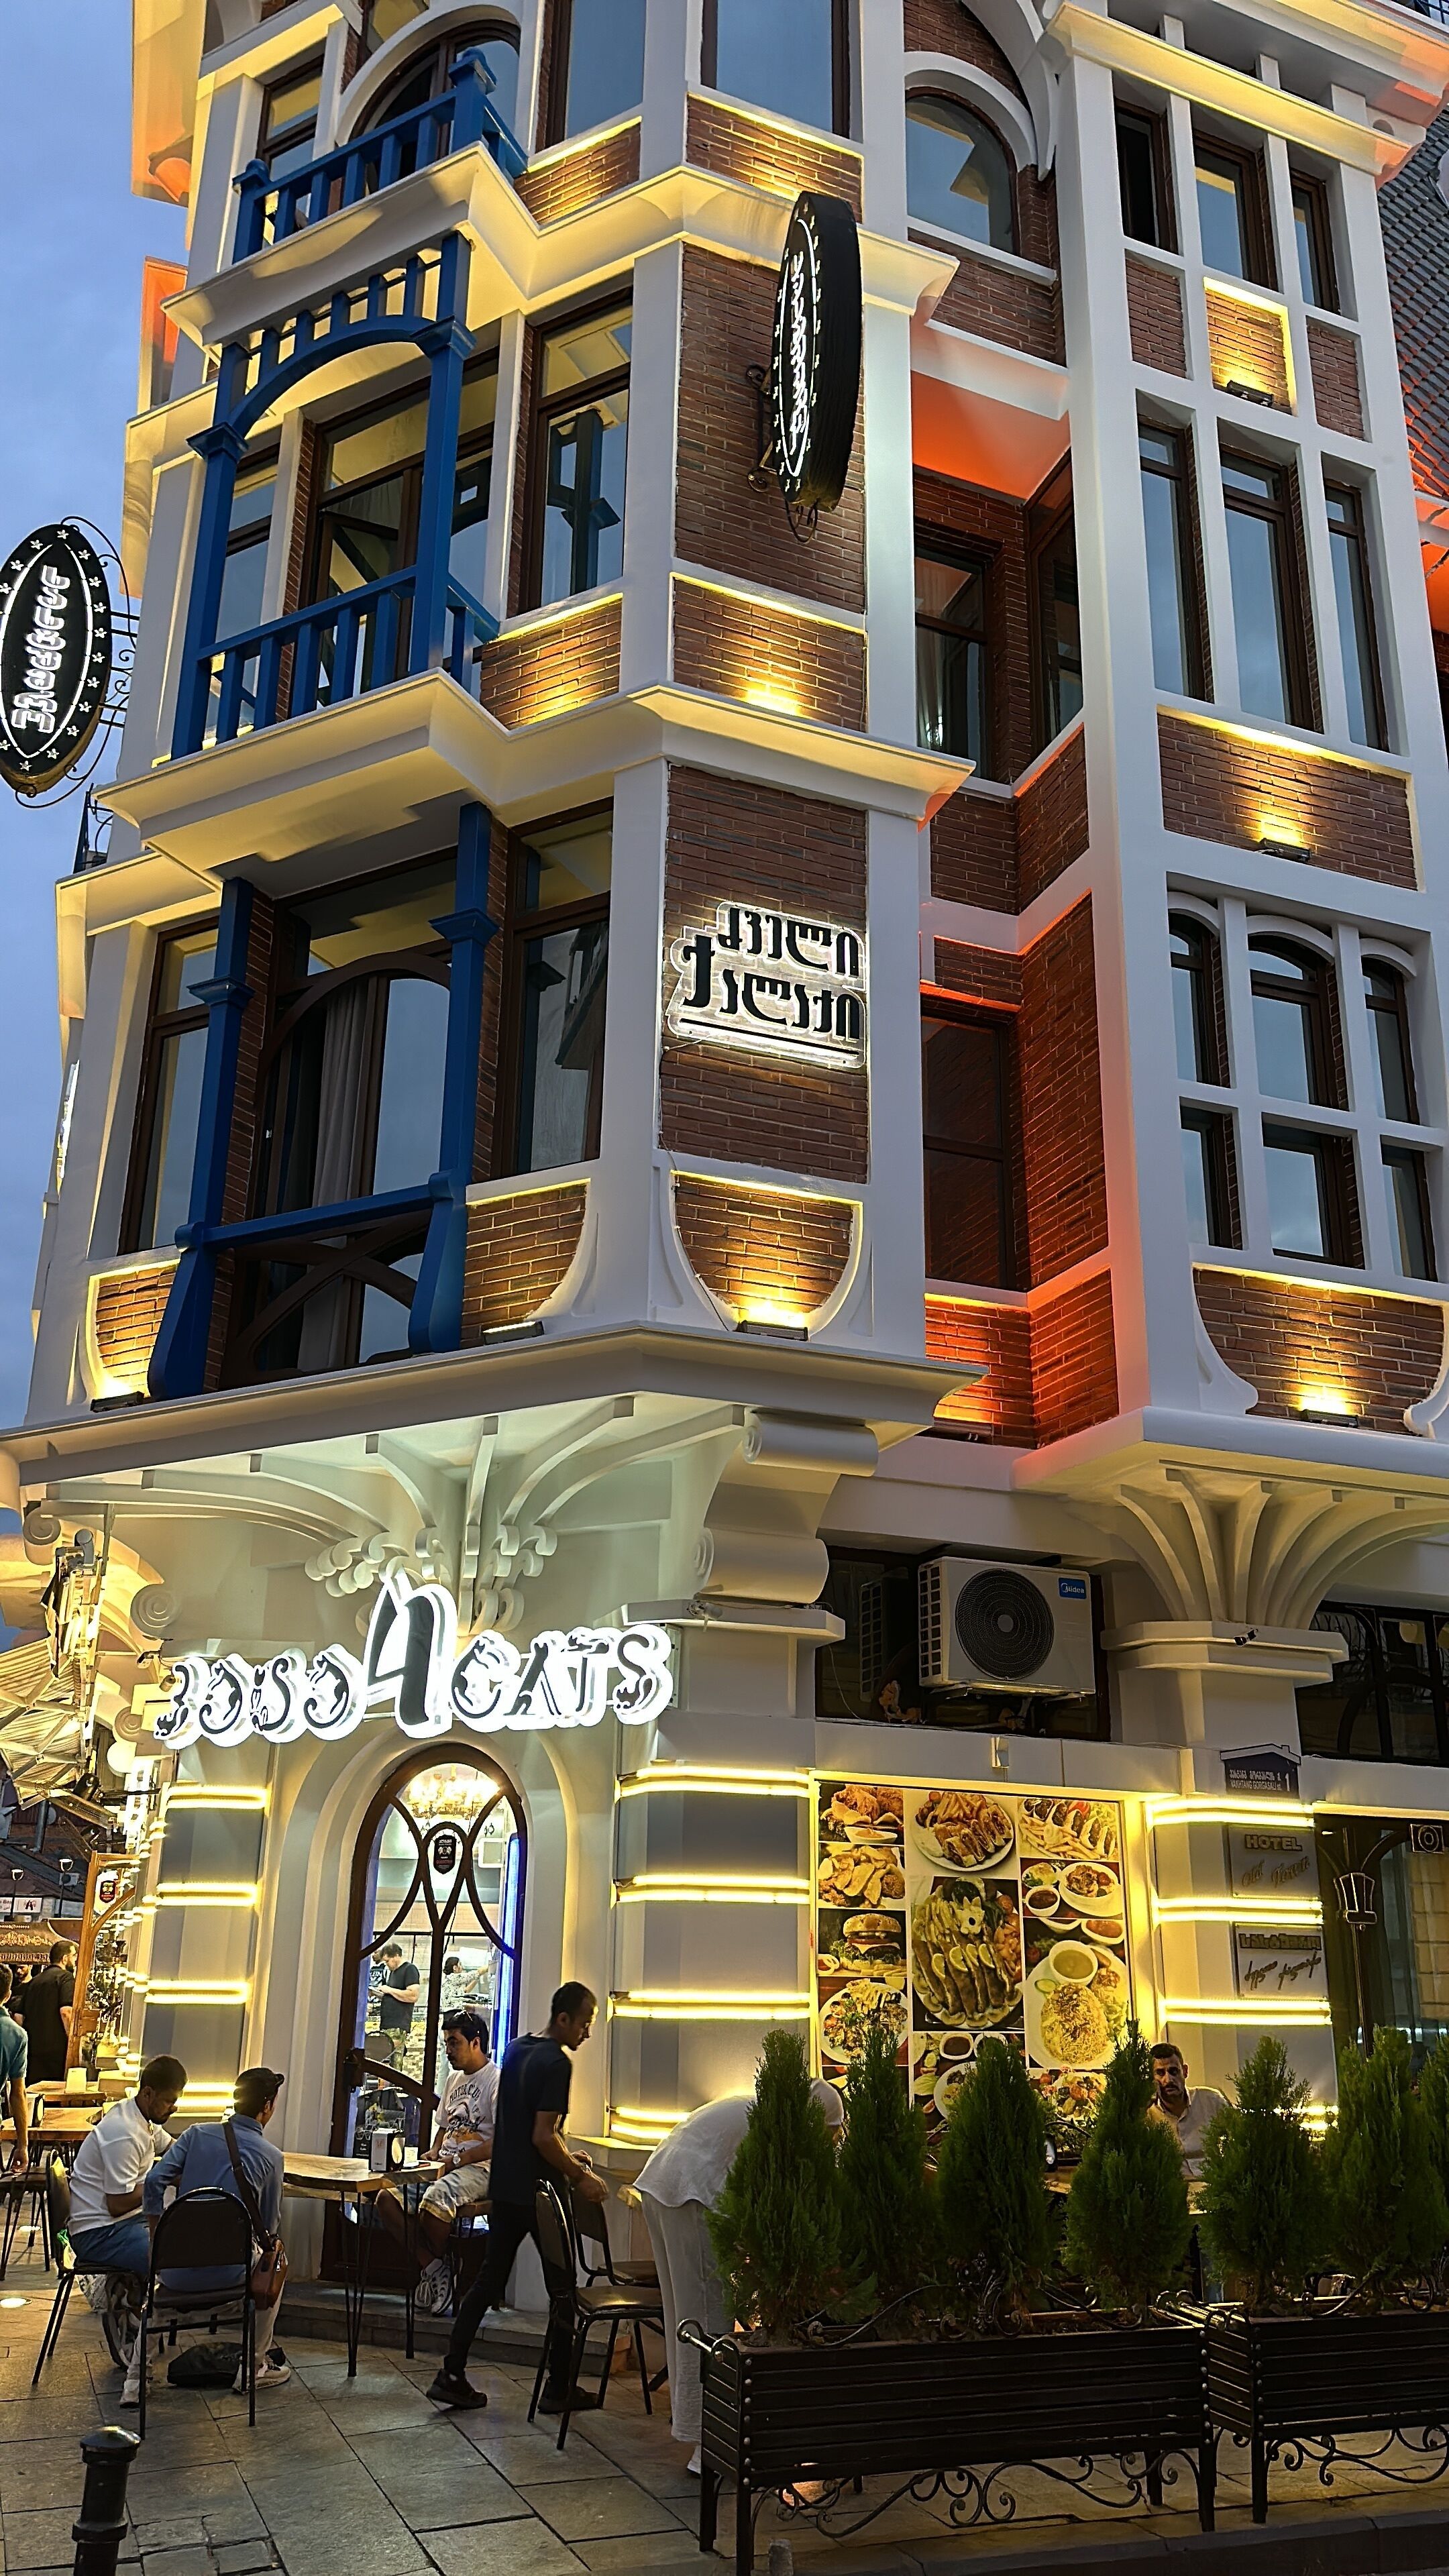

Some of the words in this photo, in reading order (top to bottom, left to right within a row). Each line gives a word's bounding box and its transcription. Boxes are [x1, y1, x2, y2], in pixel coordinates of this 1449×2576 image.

[718, 907, 859, 977] ძველი
[683, 934, 860, 1040] ქალაქი
[1061, 1582, 1085, 1593] Midea
[366, 1582, 441, 1728] 4
[453, 1629, 658, 1723] CATS
[1285, 1773, 1290, 1792] 1
[1244, 1834, 1303, 1851] HOTEL
